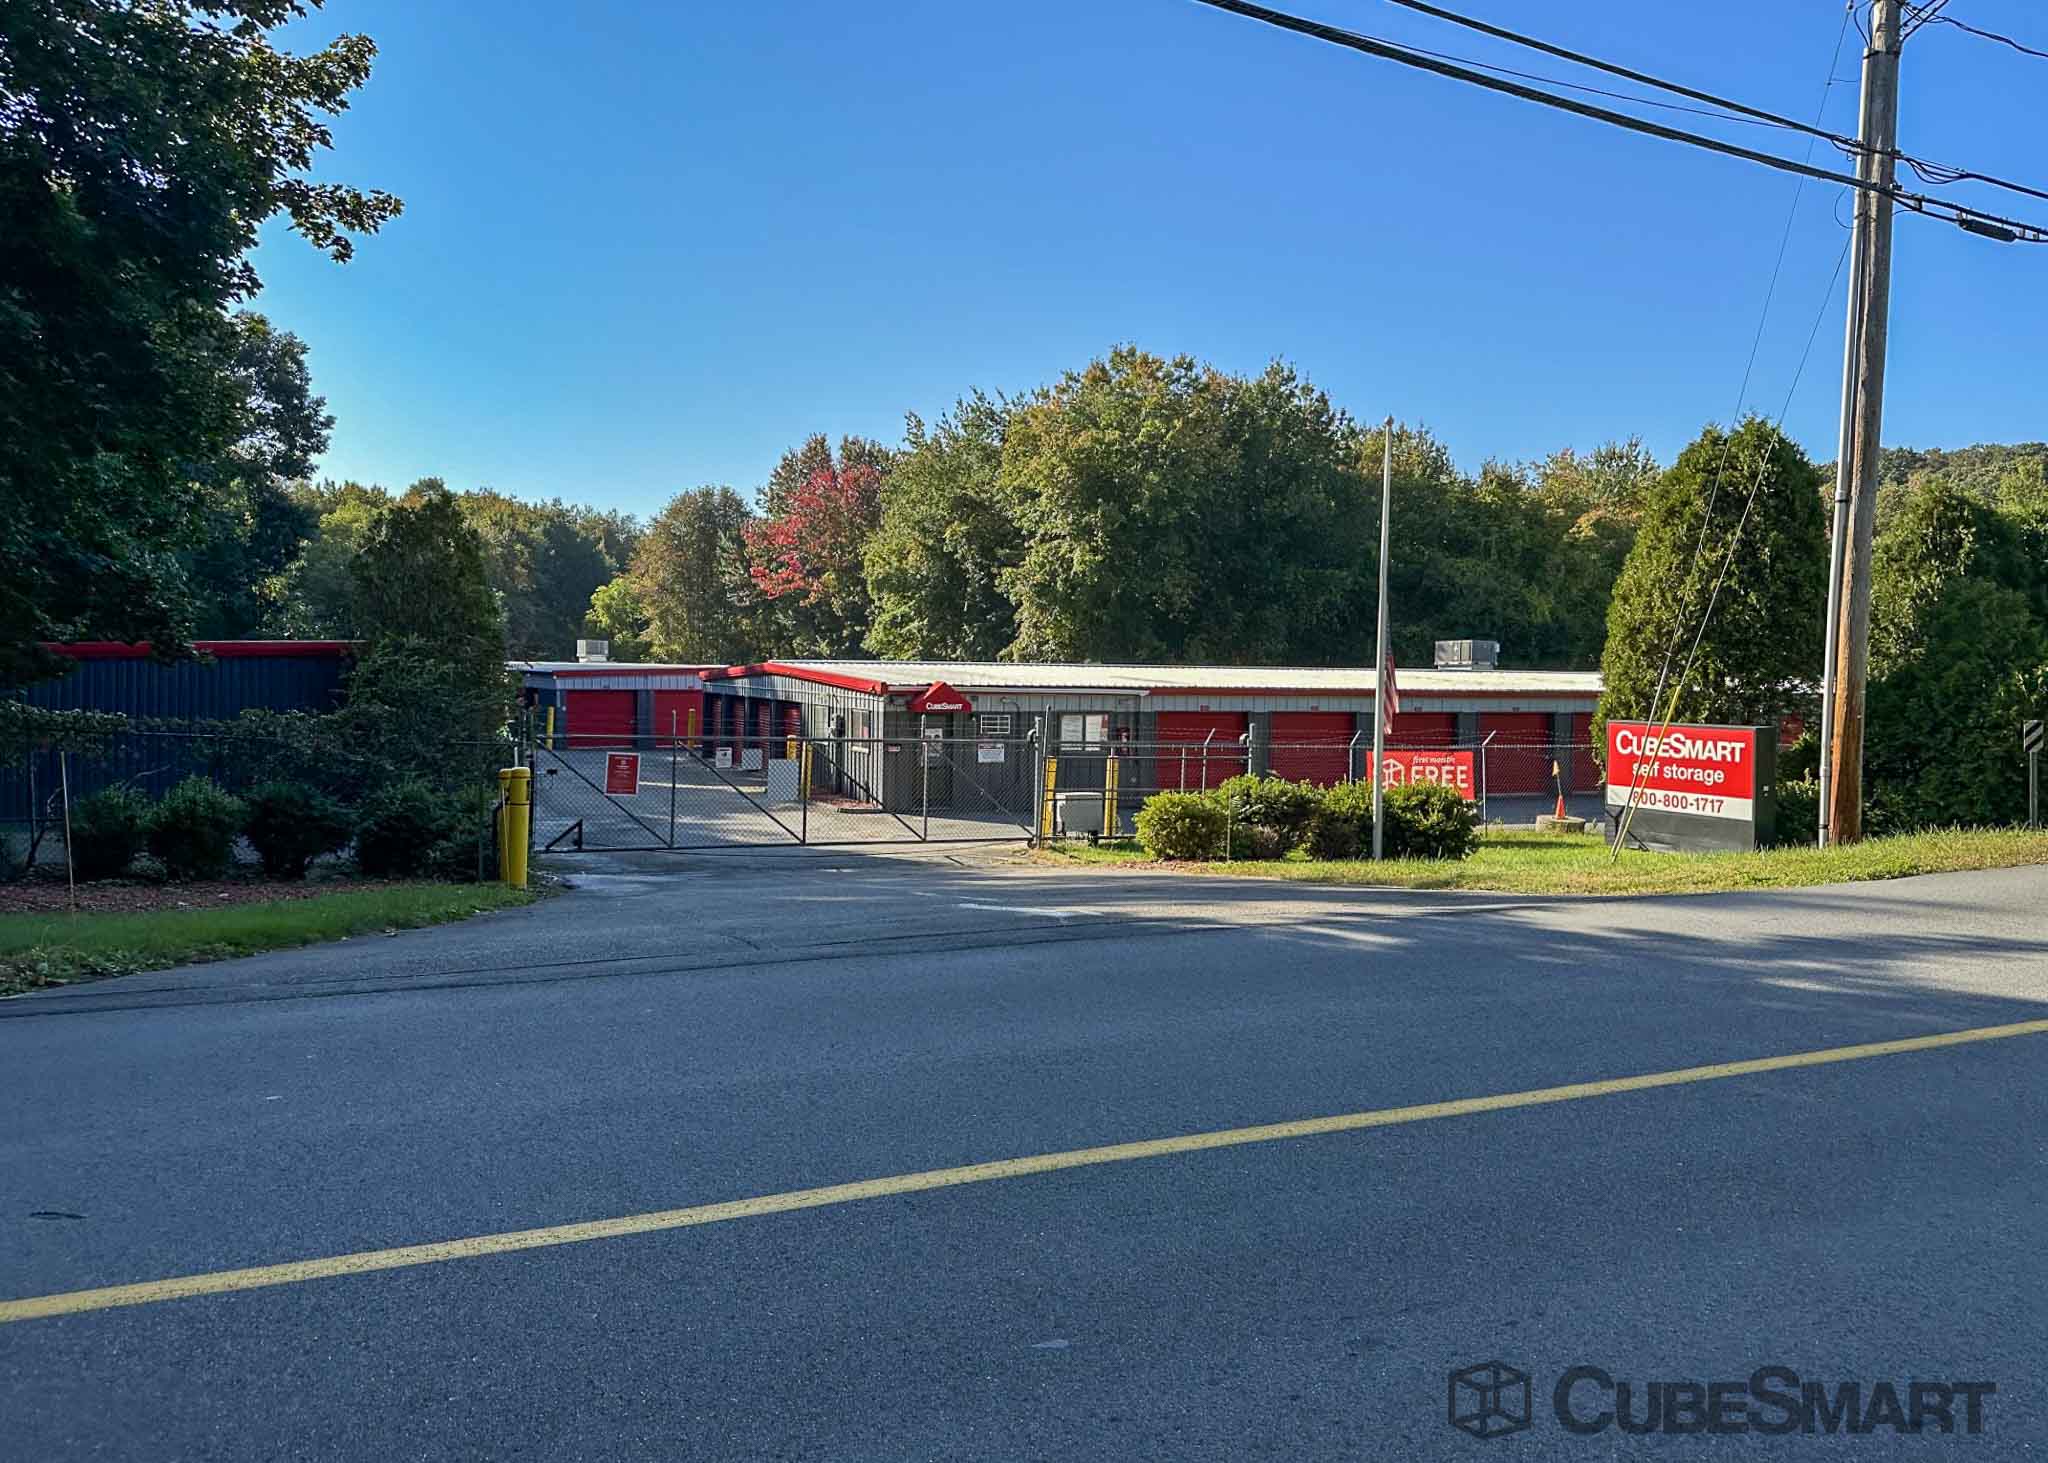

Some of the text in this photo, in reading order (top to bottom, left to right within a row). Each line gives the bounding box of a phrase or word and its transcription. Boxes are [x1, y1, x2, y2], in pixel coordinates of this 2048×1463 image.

[1411, 765, 1469, 788] FREE
[1663, 764, 1725, 786] storage
[1632, 790, 1724, 814] 800-800-1717
